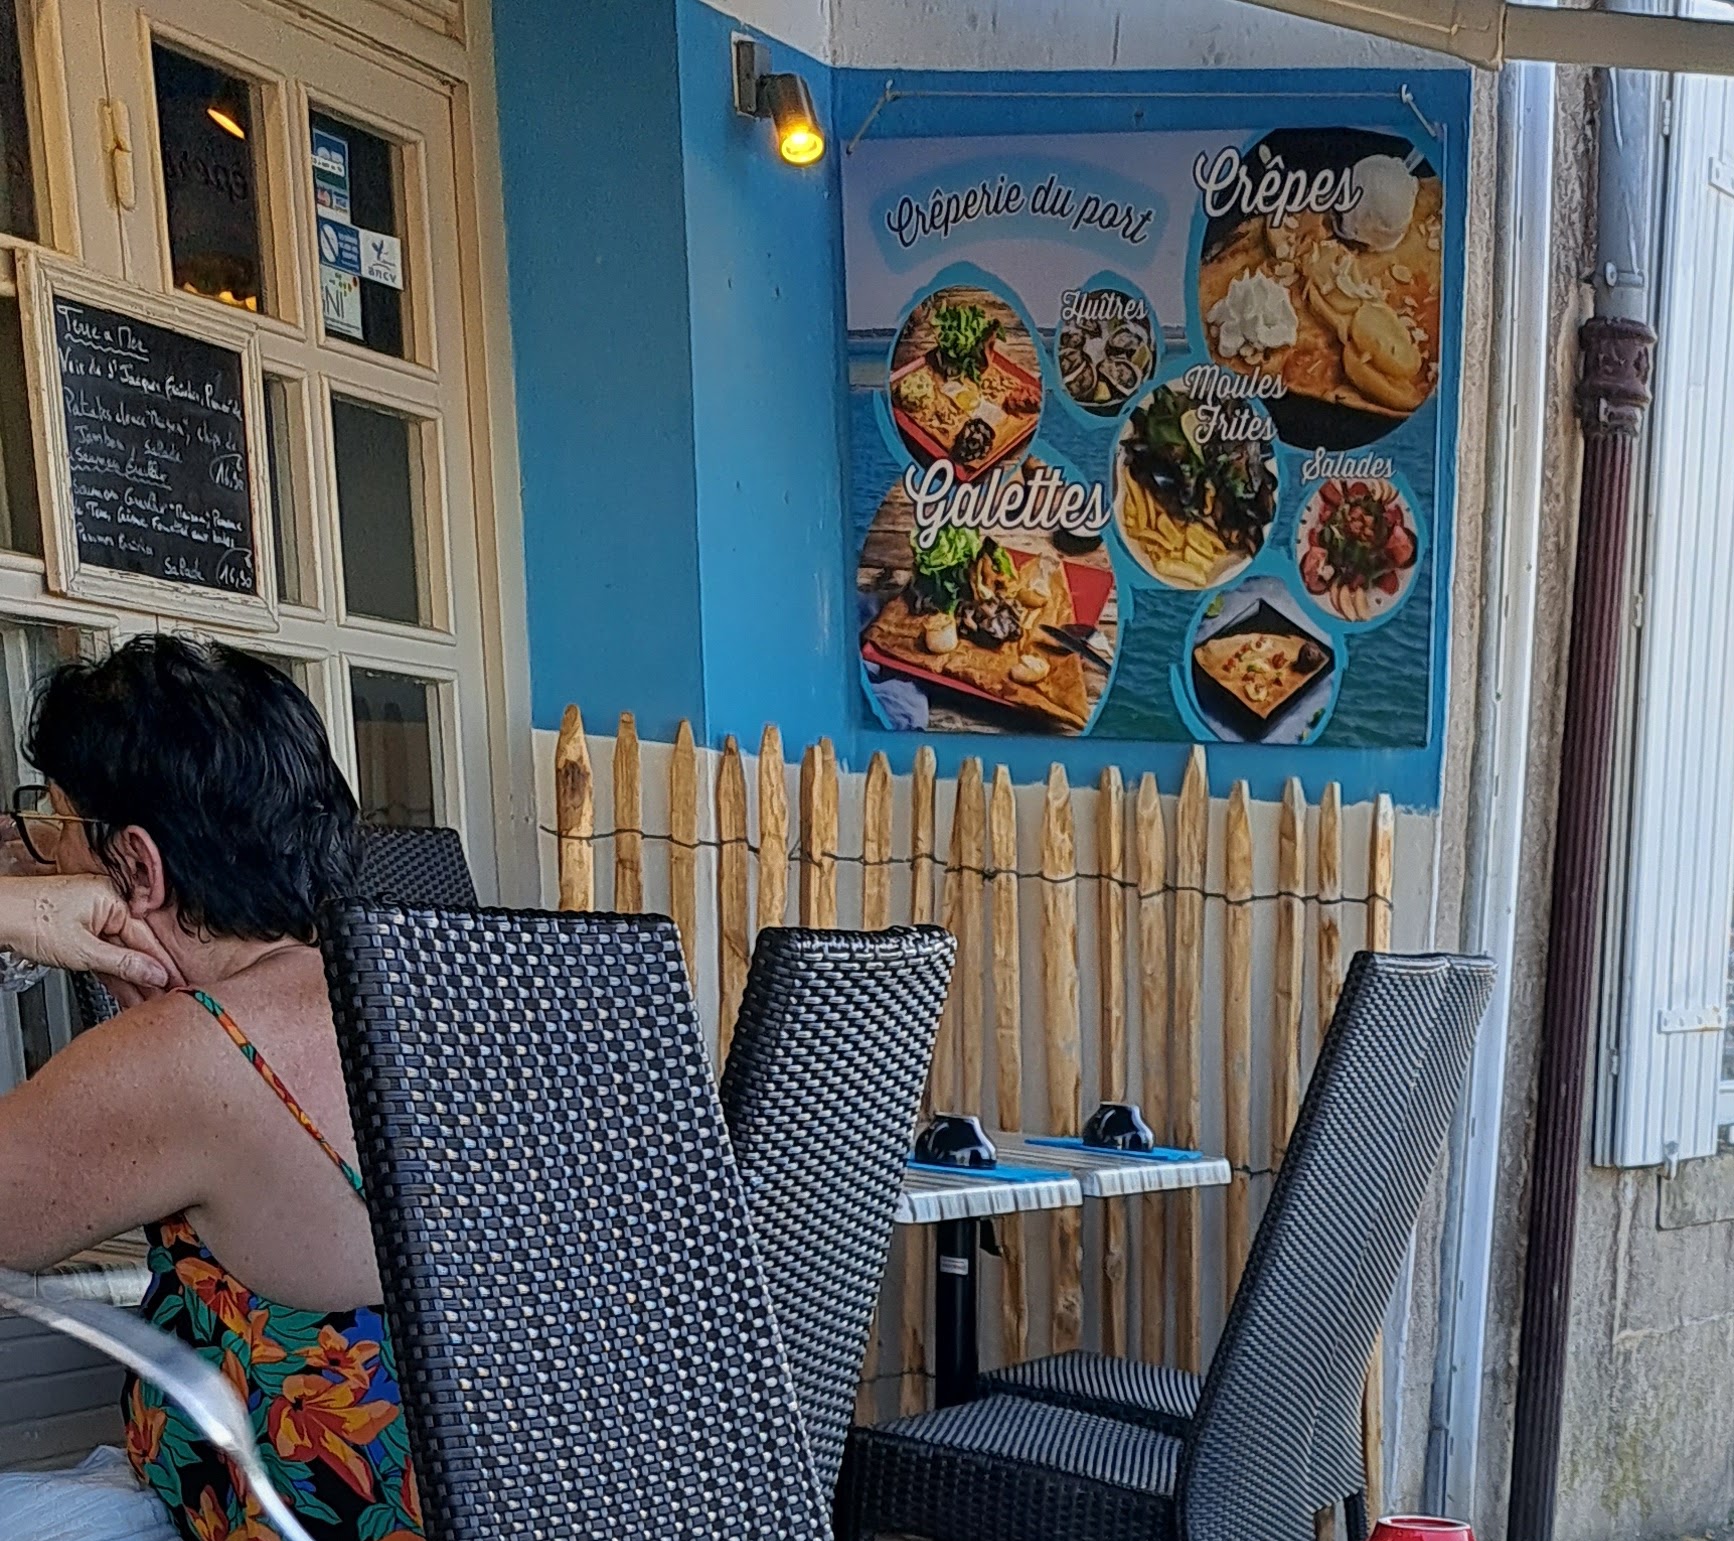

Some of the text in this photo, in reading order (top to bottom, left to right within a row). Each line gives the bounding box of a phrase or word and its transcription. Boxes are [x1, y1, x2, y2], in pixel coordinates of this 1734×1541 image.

[1195, 147, 1362, 228] Crêpes
[887, 175, 1152, 247] Crêperie du port
[1062, 291, 1149, 322] Huîtres
[1185, 364, 1287, 402] Moules
[1195, 404, 1277, 443] Frites
[1301, 446, 1396, 485] Salades
[905, 458, 1110, 549] Galettes
